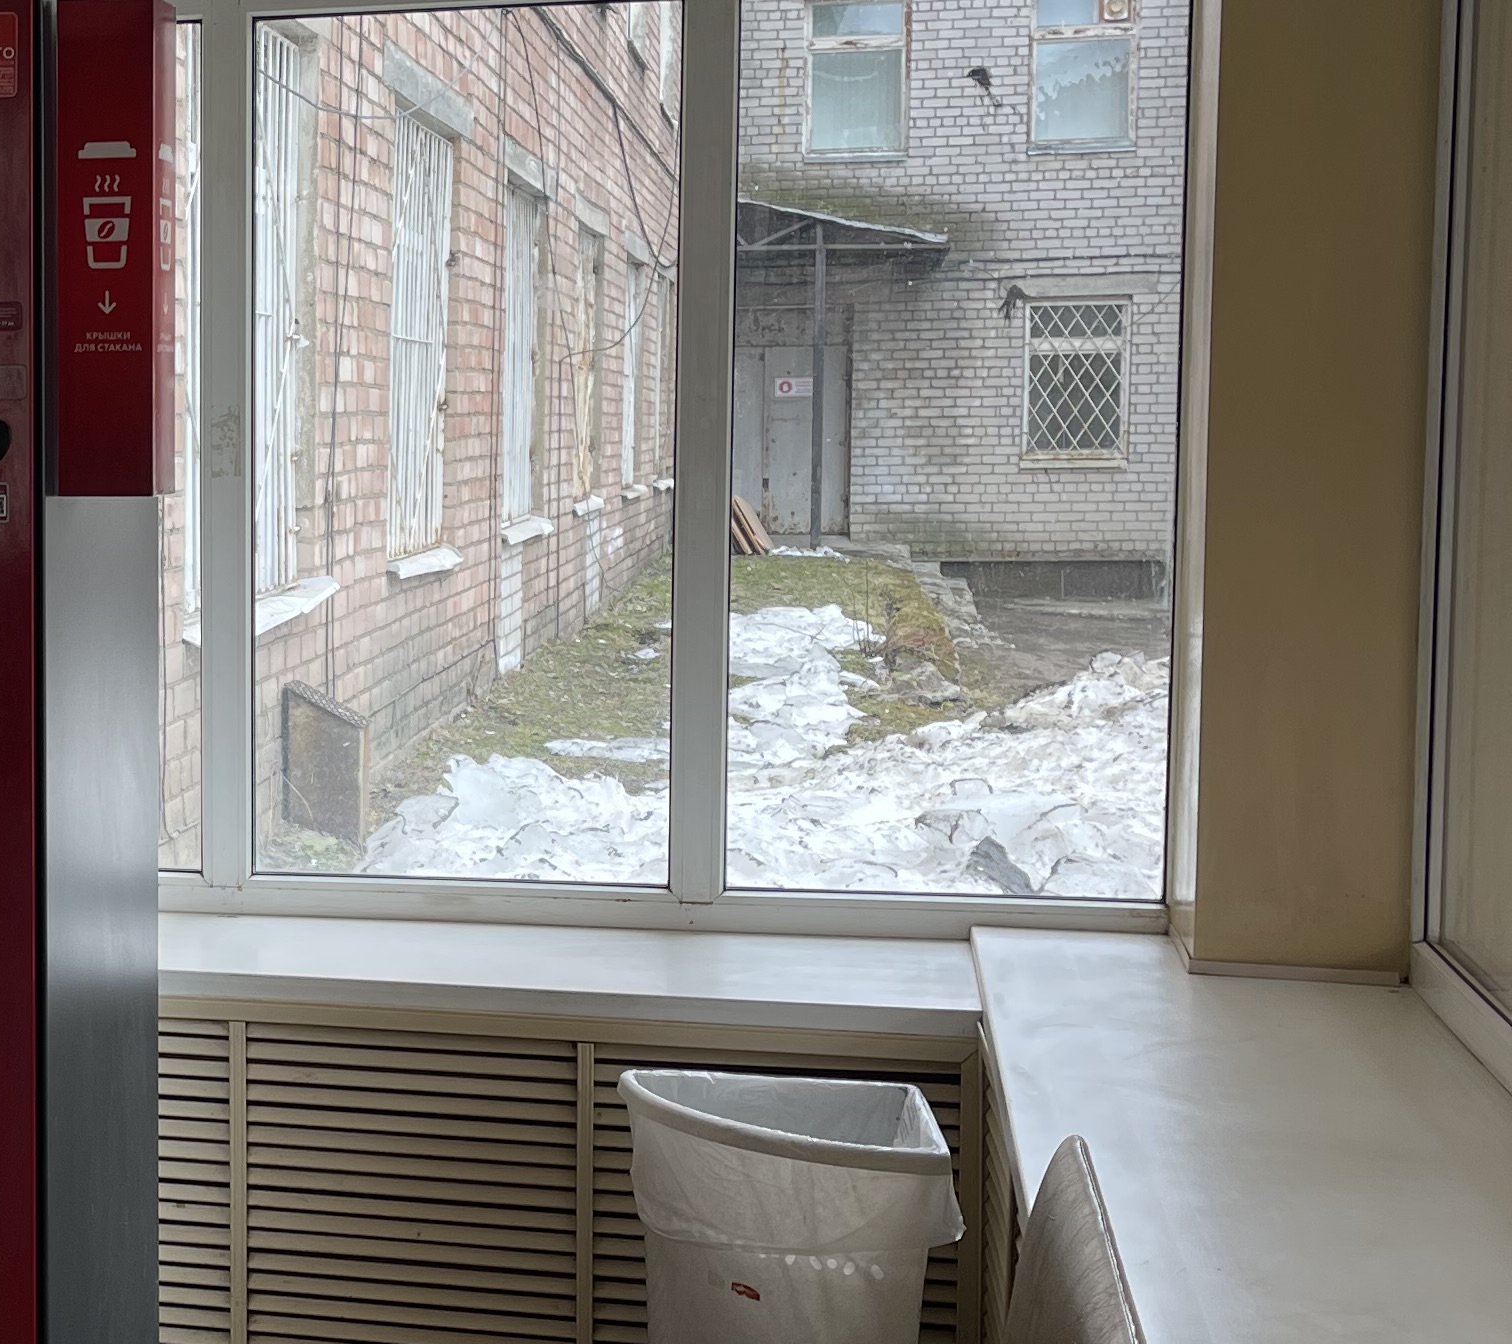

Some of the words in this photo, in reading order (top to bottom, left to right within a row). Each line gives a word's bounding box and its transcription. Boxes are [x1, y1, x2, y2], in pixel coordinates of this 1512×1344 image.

[86, 331, 131, 340] КРЫШКИ
[74, 343, 96, 353] ДЛЯ
[97, 343, 143, 352] СТАКАНА
